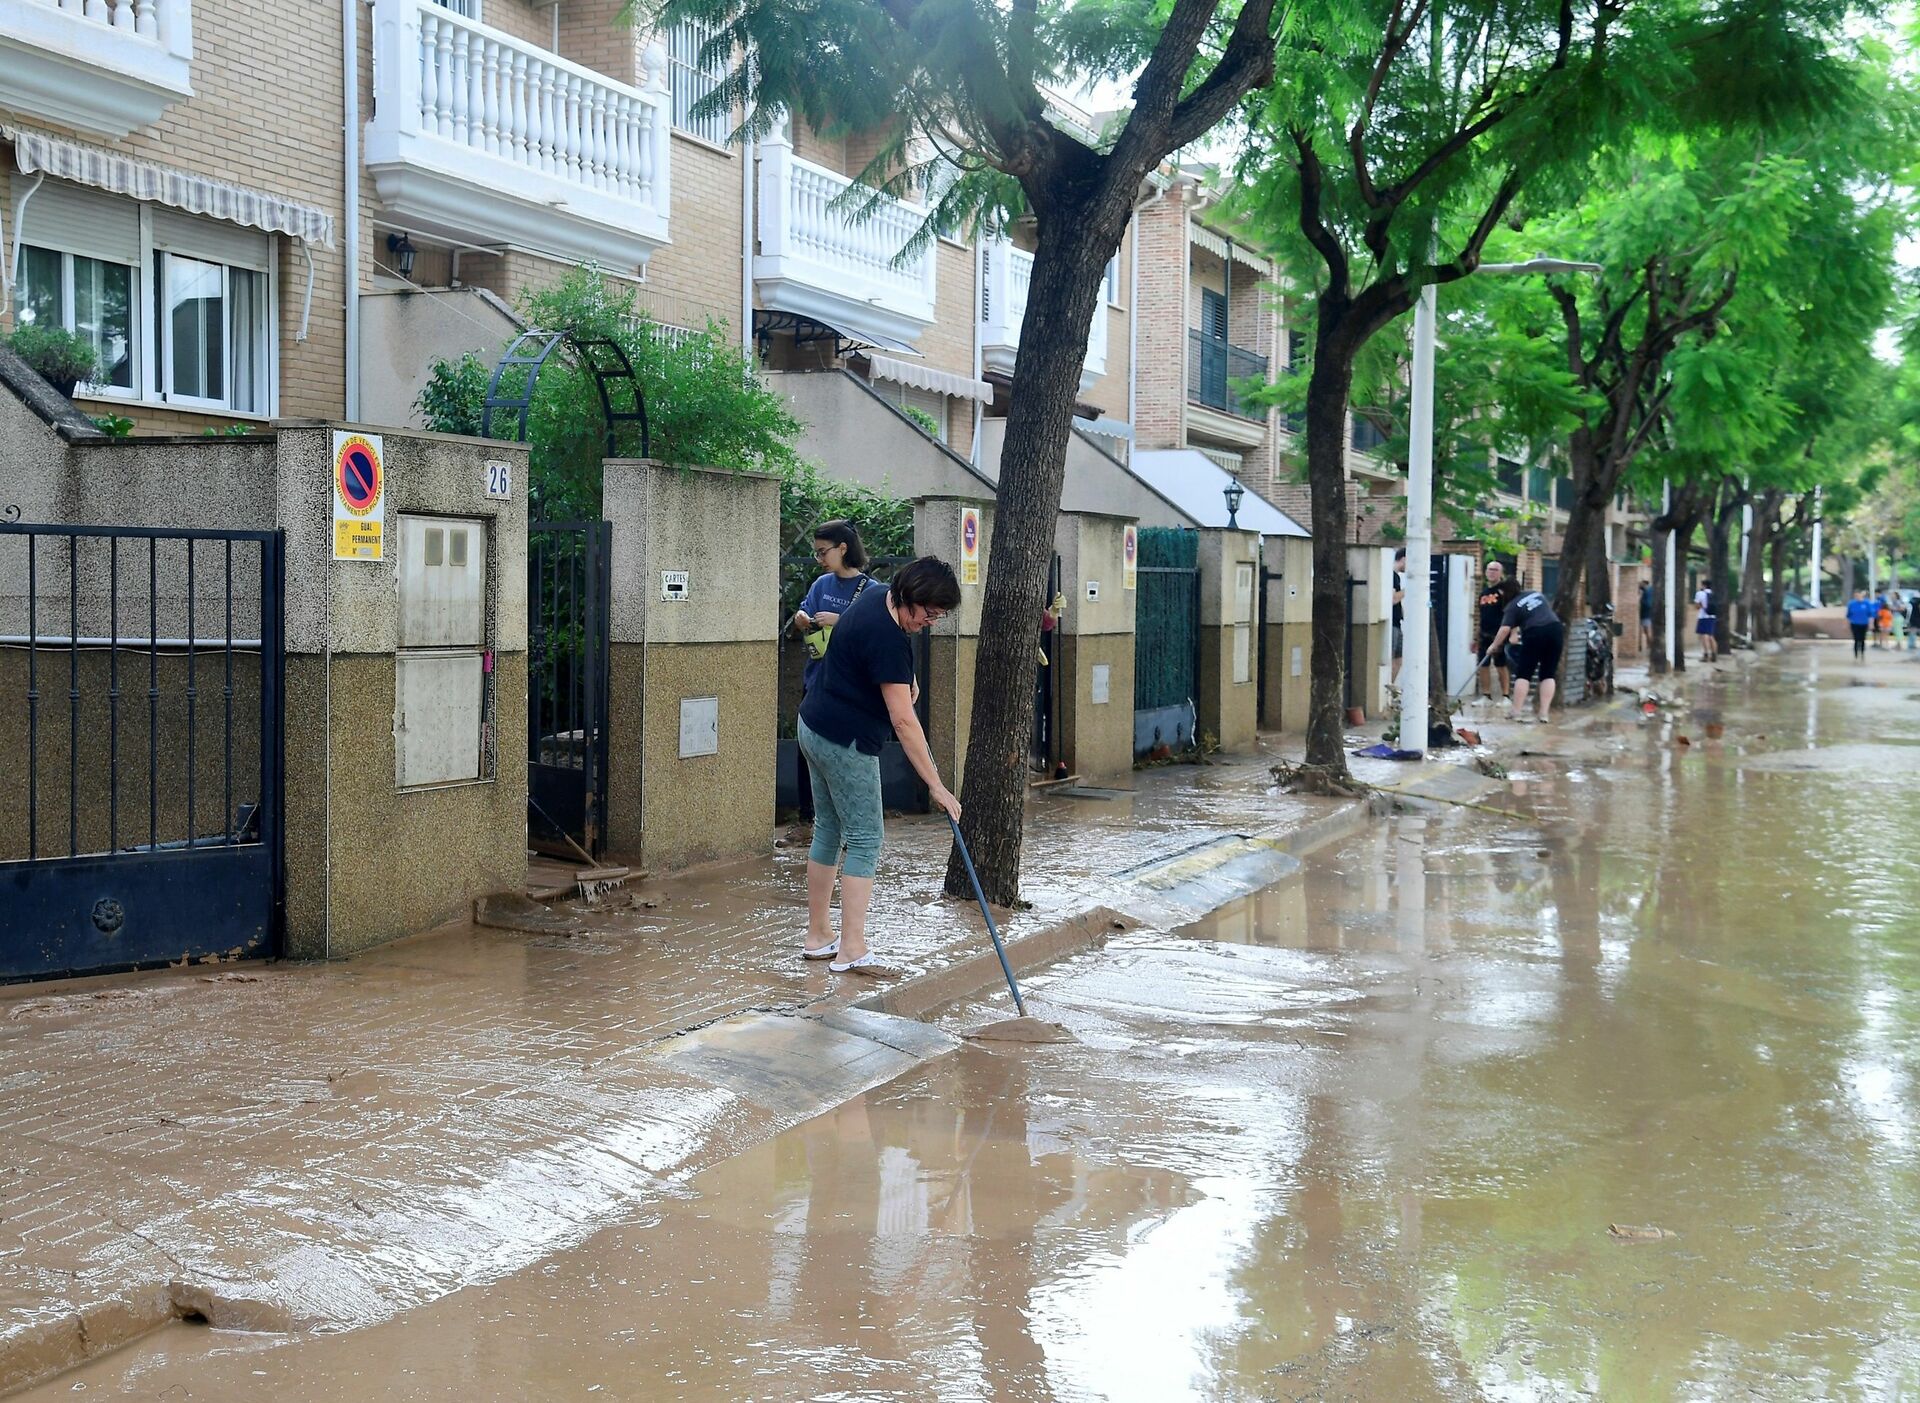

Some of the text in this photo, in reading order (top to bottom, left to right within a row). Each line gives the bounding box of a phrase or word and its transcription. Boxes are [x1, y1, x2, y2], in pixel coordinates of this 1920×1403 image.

[490, 466, 507, 494] 26
[361, 522, 372, 531] GUAL
[352, 534, 381, 544] PERMANENT
[665, 574, 686, 583] CARTES
